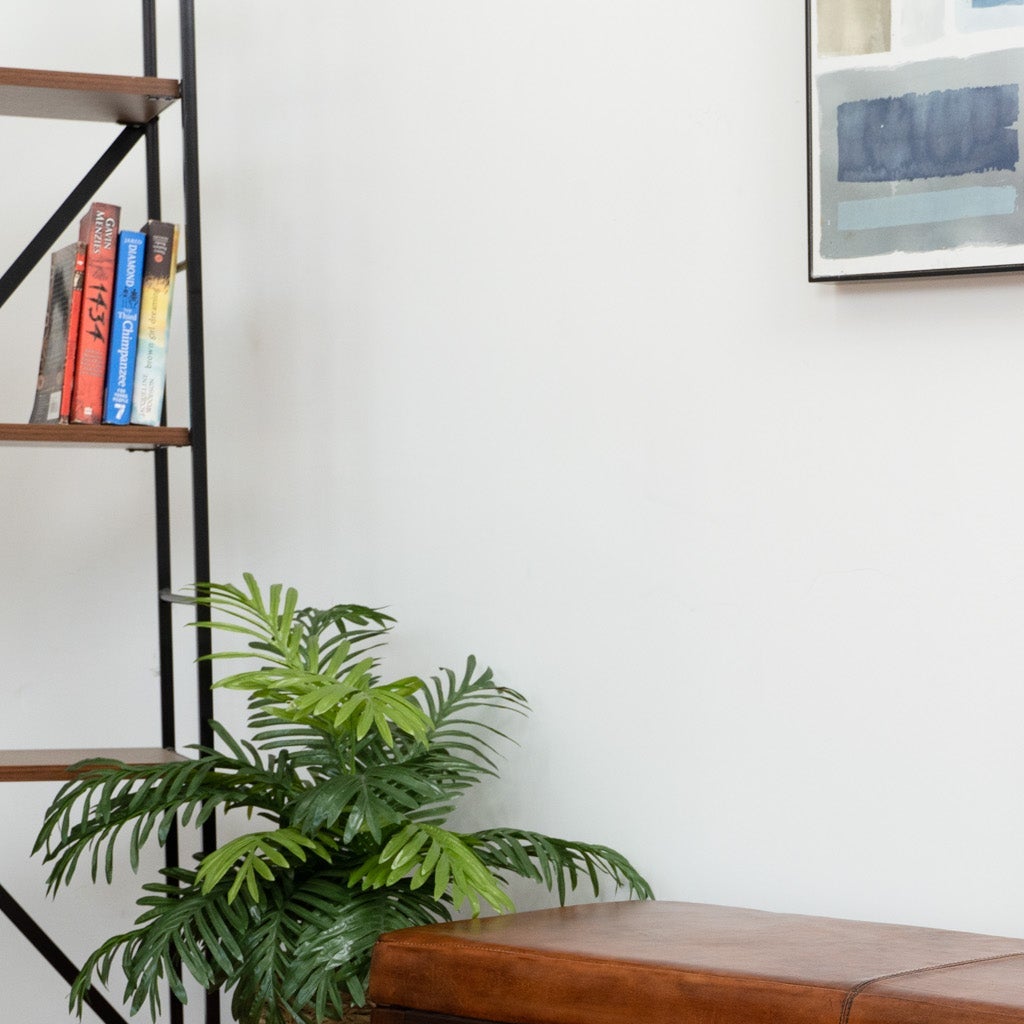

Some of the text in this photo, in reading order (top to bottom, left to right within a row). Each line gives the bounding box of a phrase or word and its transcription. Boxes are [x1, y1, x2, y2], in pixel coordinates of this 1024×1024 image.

[93, 210, 104, 254] MENZIES
[126, 244, 137, 287] DIAMOND
[86, 284, 107, 343] 1434
[117, 320, 134, 388] Chimpanzee
